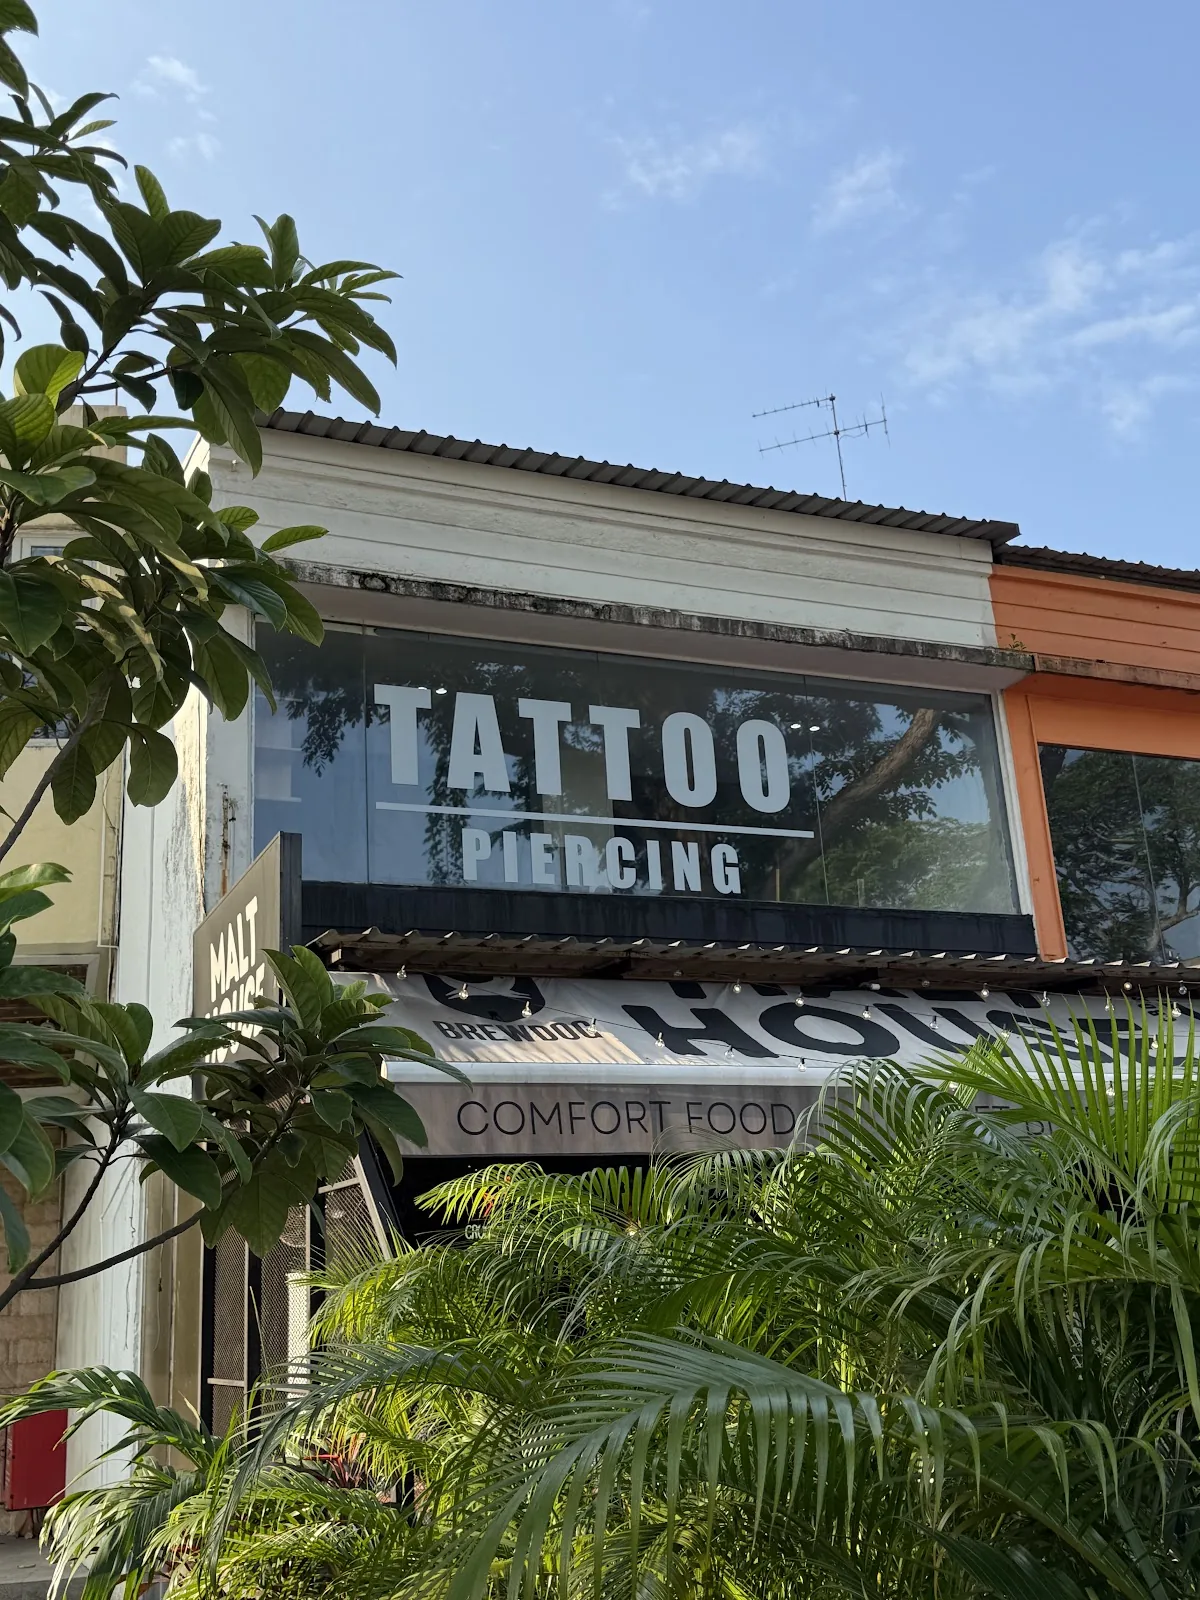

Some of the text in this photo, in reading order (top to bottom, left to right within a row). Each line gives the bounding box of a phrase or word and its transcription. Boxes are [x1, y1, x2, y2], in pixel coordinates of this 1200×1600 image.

[374, 683, 791, 813] TATTOO
[461, 828, 742, 895] PIERCING
[210, 895, 258, 1003] MALT
[432, 1020, 604, 1042] BREWDOG
[456, 1100, 795, 1136] COMFORT FOOD
